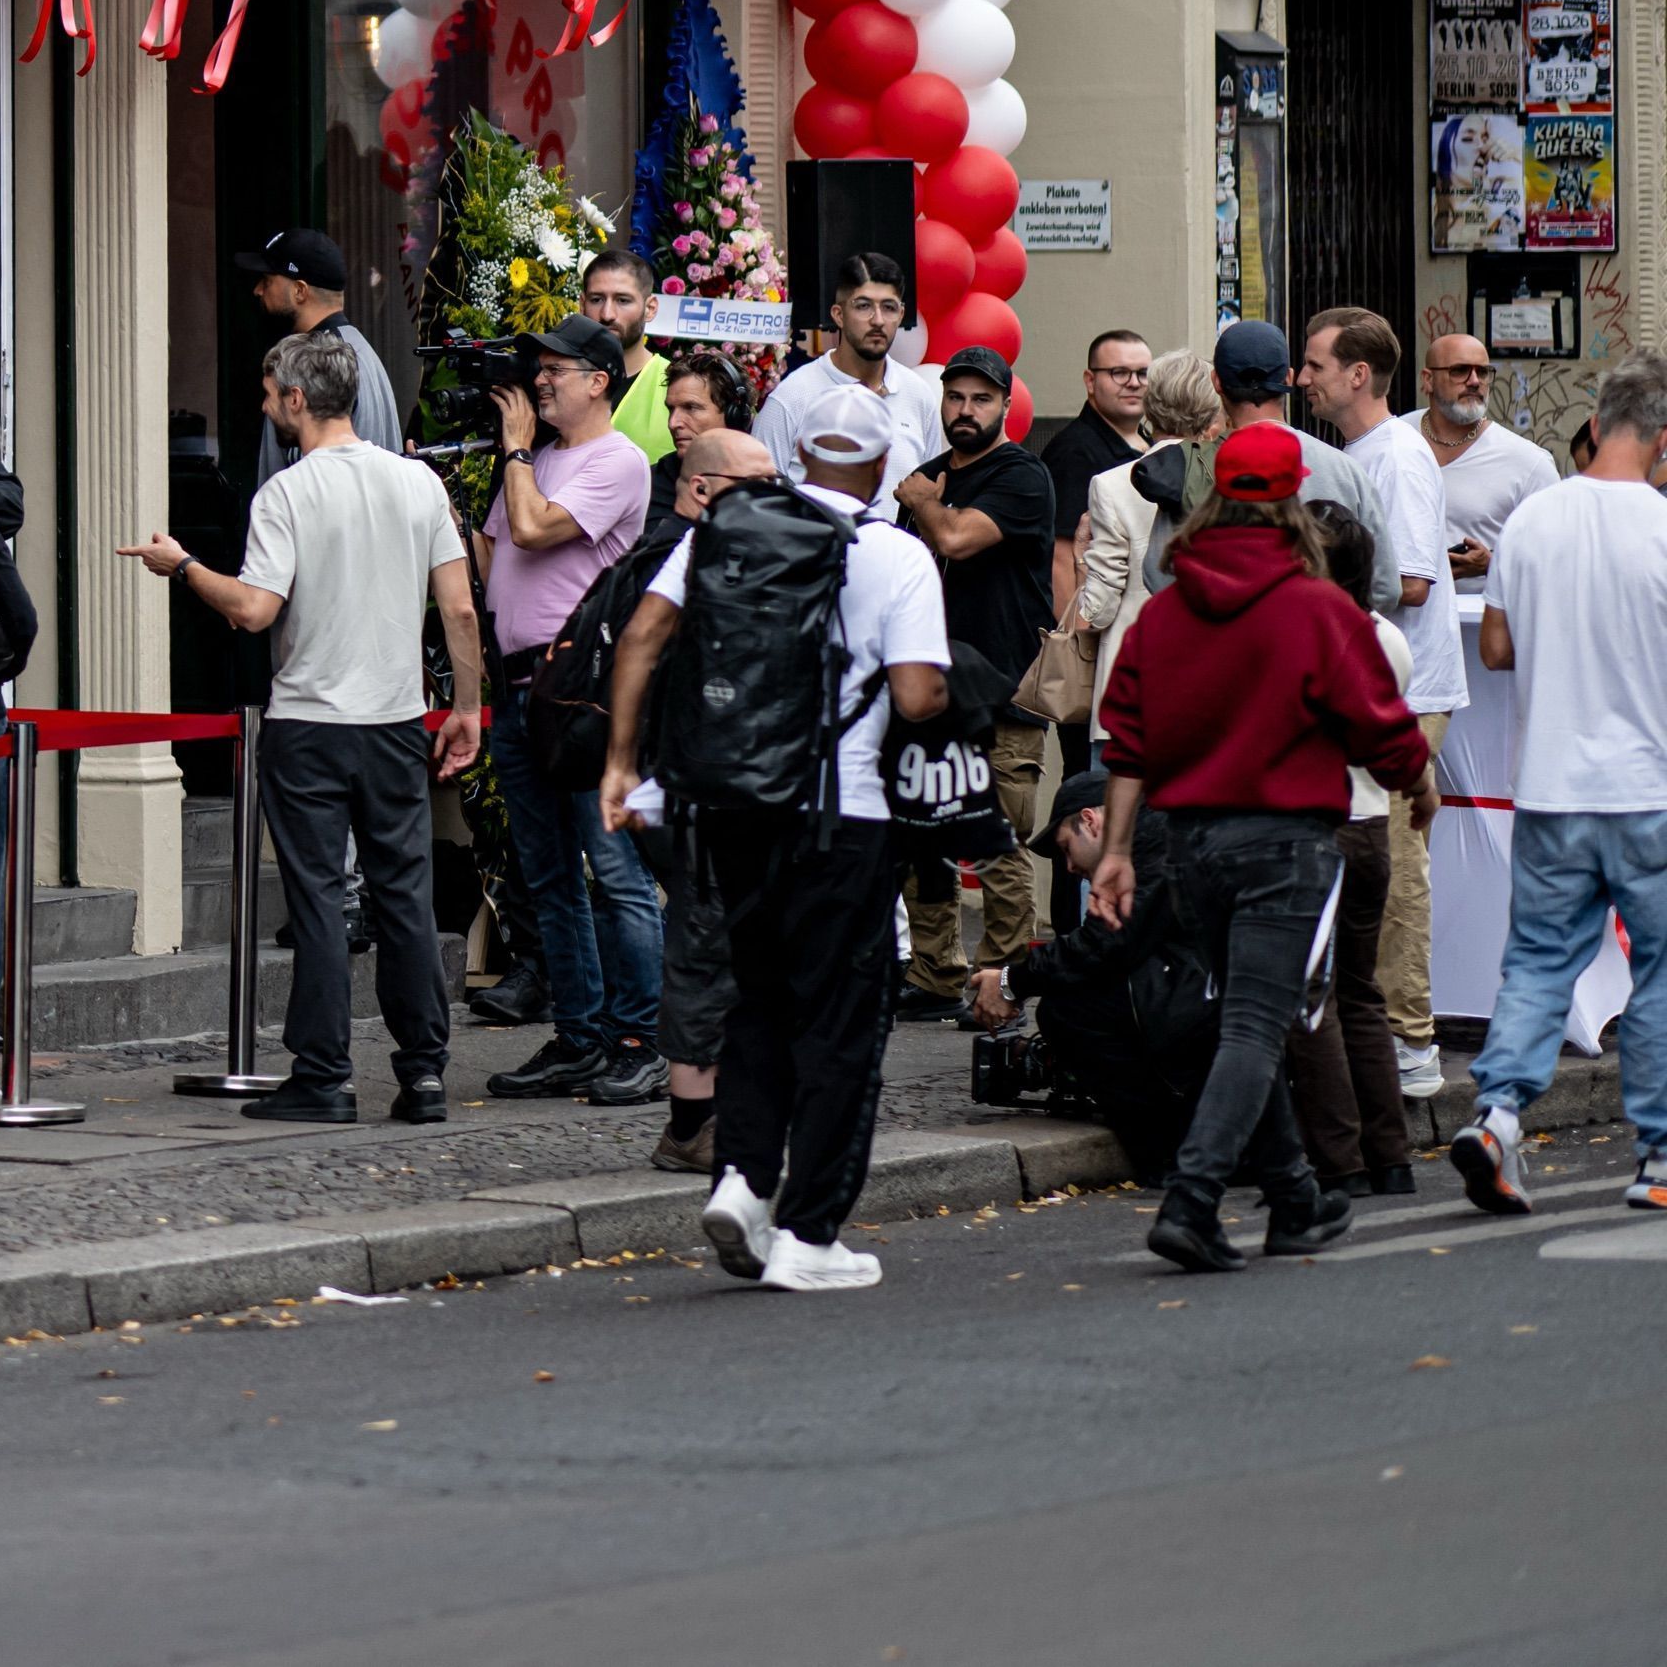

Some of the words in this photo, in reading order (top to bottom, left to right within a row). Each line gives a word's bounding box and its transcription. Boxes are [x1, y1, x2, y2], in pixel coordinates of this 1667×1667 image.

[1536, 66, 1588, 81] BERLIN
[1436, 81, 1476, 98] BERLIN
[1534, 120, 1604, 142] KUMBIA
[1534, 137, 1605, 159] QUEERS
[1046, 185, 1081, 199] Plakate
[1019, 201, 1062, 215] ankleben
[713, 311, 783, 328] GASTRO
[713, 324, 732, 333] A-Z
[733, 326, 748, 335] für
[750, 328, 764, 336] die
[896, 740, 991, 805] 9n16
